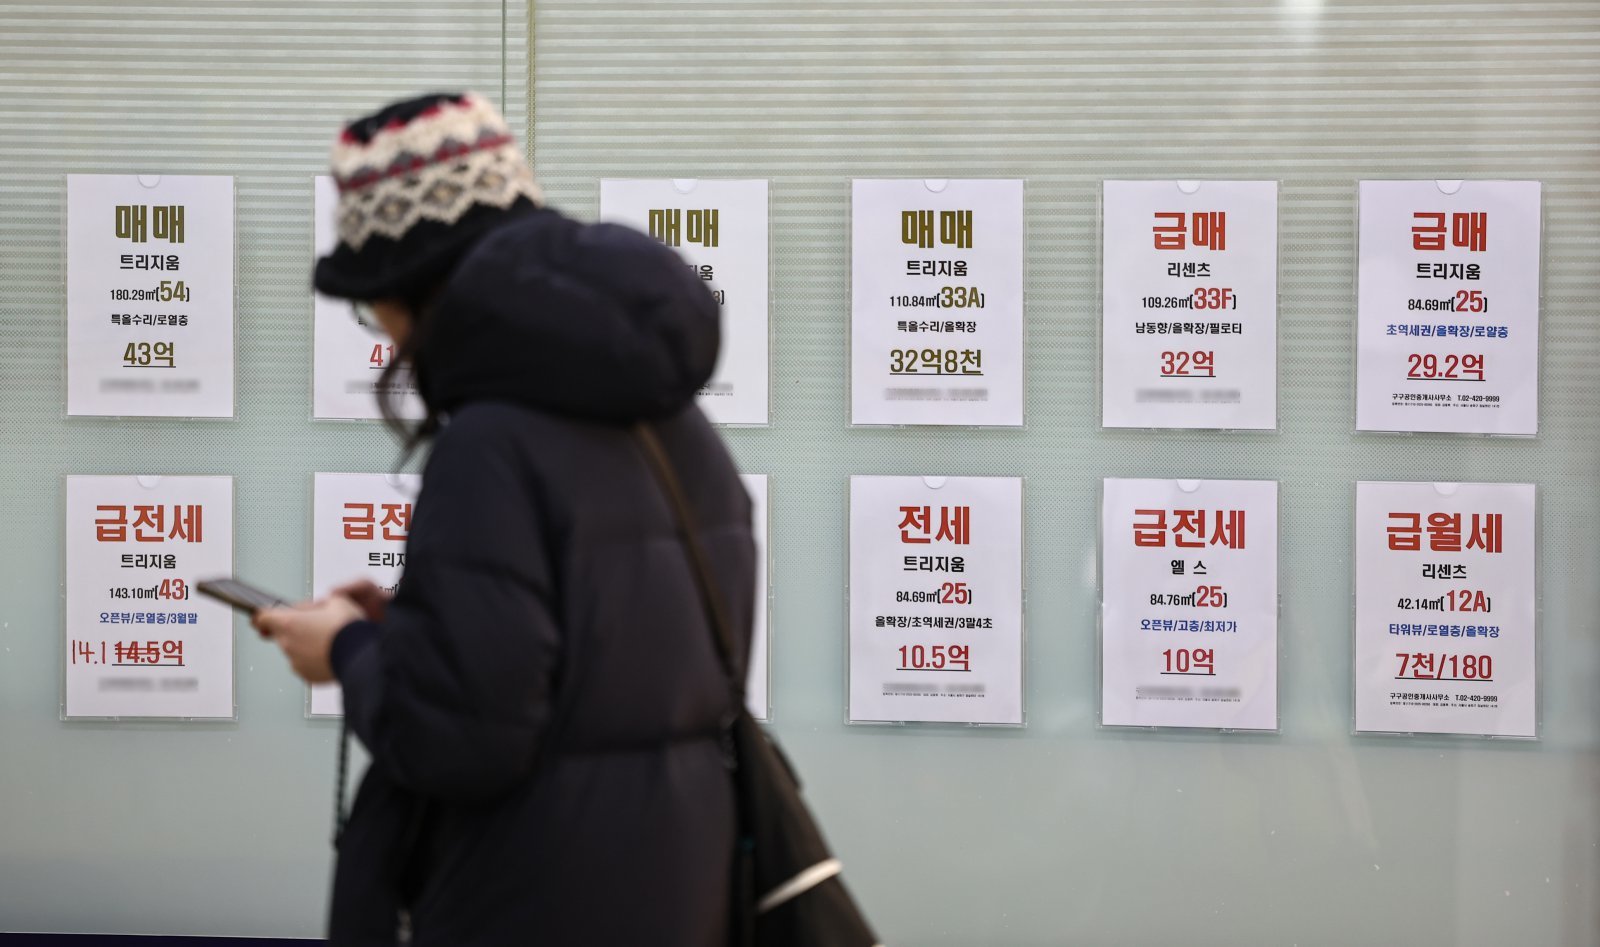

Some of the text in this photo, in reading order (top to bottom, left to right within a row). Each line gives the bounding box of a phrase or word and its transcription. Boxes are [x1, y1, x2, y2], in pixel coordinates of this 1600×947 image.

[115, 205, 185, 244] 매매
[901, 210, 973, 249] 매매
[1152, 212, 1226, 251] 급매
[1411, 212, 1488, 252] 급매
[119, 254, 180, 271] 트리지움
[906, 260, 968, 277] 트리지움
[1167, 262, 1211, 278] 리센츠
[1416, 262, 1481, 281] 트리지움
[123, 341, 174, 366] 43억
[890, 348, 982, 374] 32억8천
[1160, 350, 1214, 376] 32억
[1407, 353, 1484, 378] 29.2억
[94, 505, 203, 543] 급전세
[342, 503, 412, 541] 급전
[897, 506, 970, 545] 전세
[1132, 510, 1246, 550] 급전세
[1386, 513, 1503, 554] 급월세
[120, 553, 177, 570] 트리지움
[903, 555, 965, 573] 트리지움
[1422, 563, 1467, 580] 리센츠
[898, 644, 969, 669] 10.5억
[1163, 648, 1214, 675] 10억
[1395, 652, 1493, 678] 7천/180
